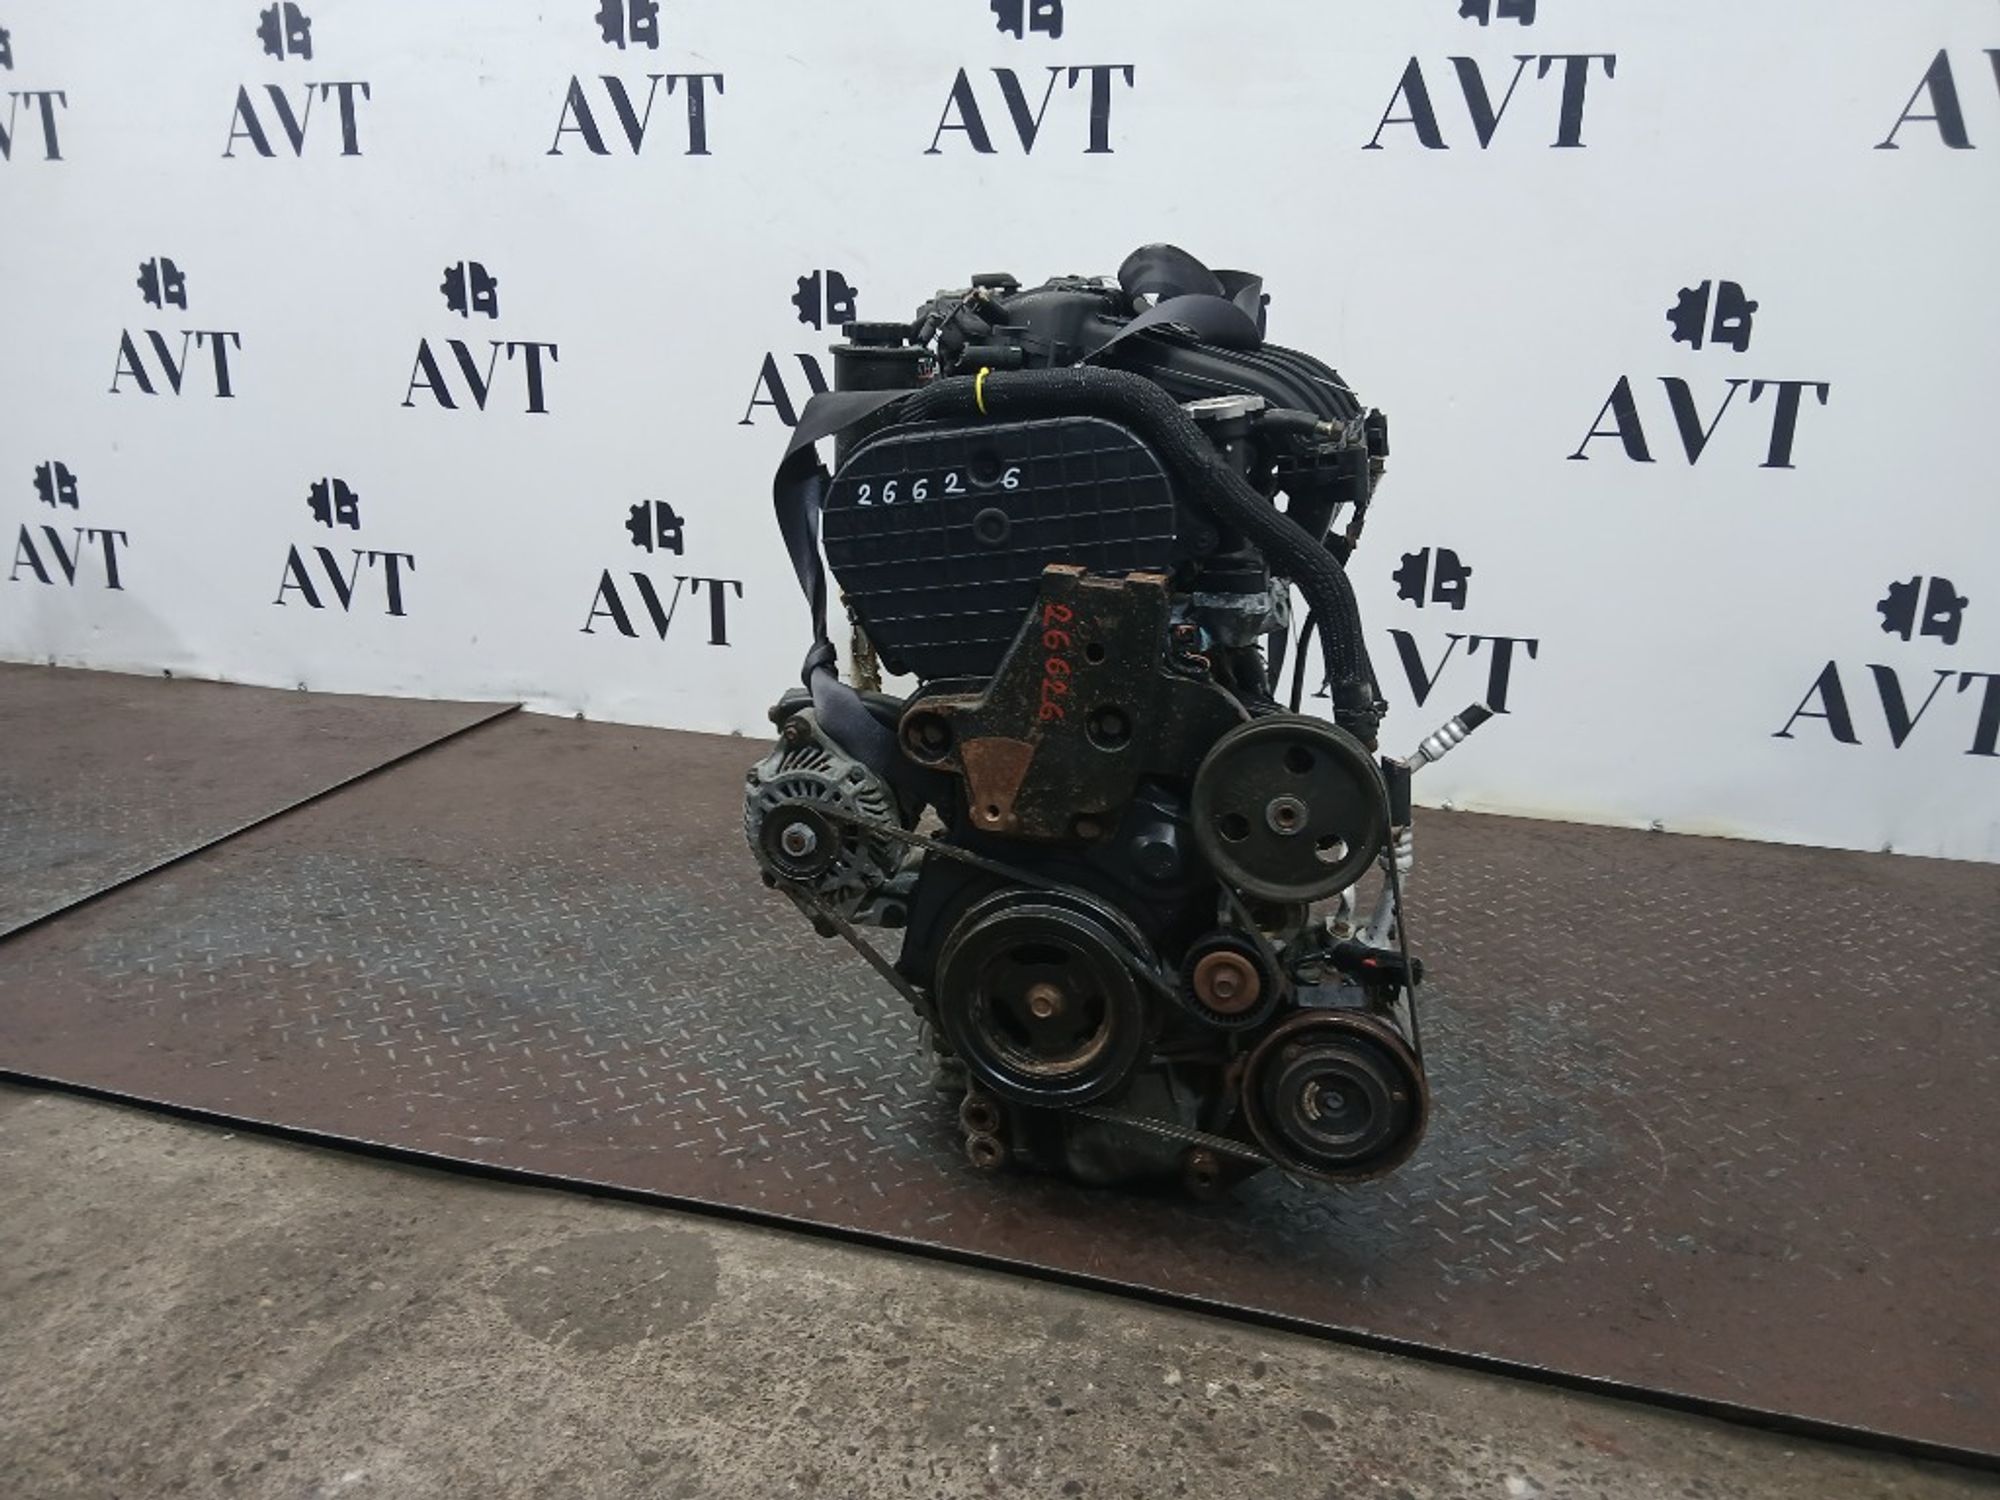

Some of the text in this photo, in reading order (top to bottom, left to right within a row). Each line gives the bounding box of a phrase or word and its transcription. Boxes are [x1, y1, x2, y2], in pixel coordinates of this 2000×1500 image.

[221, 81, 370, 158] AVT
[546, 73, 724, 156] AVT
[924, 64, 1135, 155] AVT
[1361, 54, 1617, 150] AVT
[1873, 48, 2000, 150] A
[108, 328, 241, 398] AVT
[401, 337, 559, 414] AVT
[1566, 374, 1831, 469] AVT
[857, 467, 1021, 505] 26626
[9, 523, 128, 591] AVT
[271, 543, 415, 617] AVT
[579, 568, 743, 646] AVT
[1311, 628, 1539, 714] VT
[1771, 659, 2000, 757] AVT
